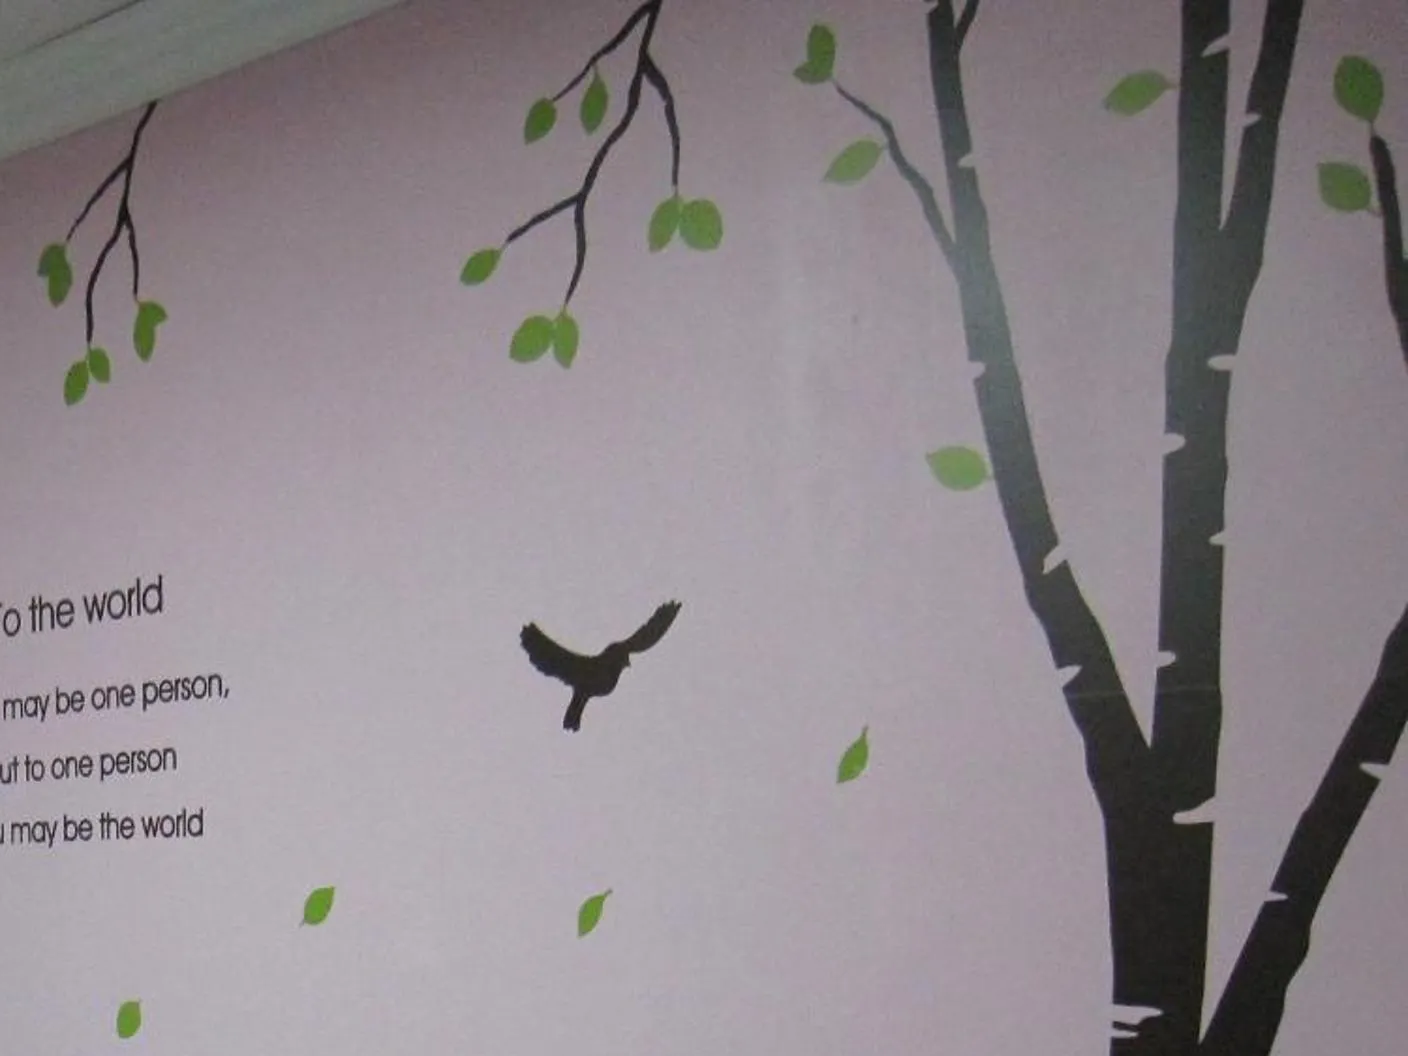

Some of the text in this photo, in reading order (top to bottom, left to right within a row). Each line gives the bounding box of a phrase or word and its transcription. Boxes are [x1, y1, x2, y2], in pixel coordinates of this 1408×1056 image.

[28, 596, 75, 632] the
[83, 574, 163, 624] world
[2, 694, 49, 722] may
[55, 686, 85, 714] be
[91, 683, 135, 710] one
[142, 673, 230, 711] person,
[24, 755, 44, 782] to
[51, 754, 93, 780] one
[100, 747, 177, 781] person
[10, 820, 57, 848] may
[63, 814, 93, 841] be
[99, 812, 135, 840] the
[141, 807, 204, 838] world
